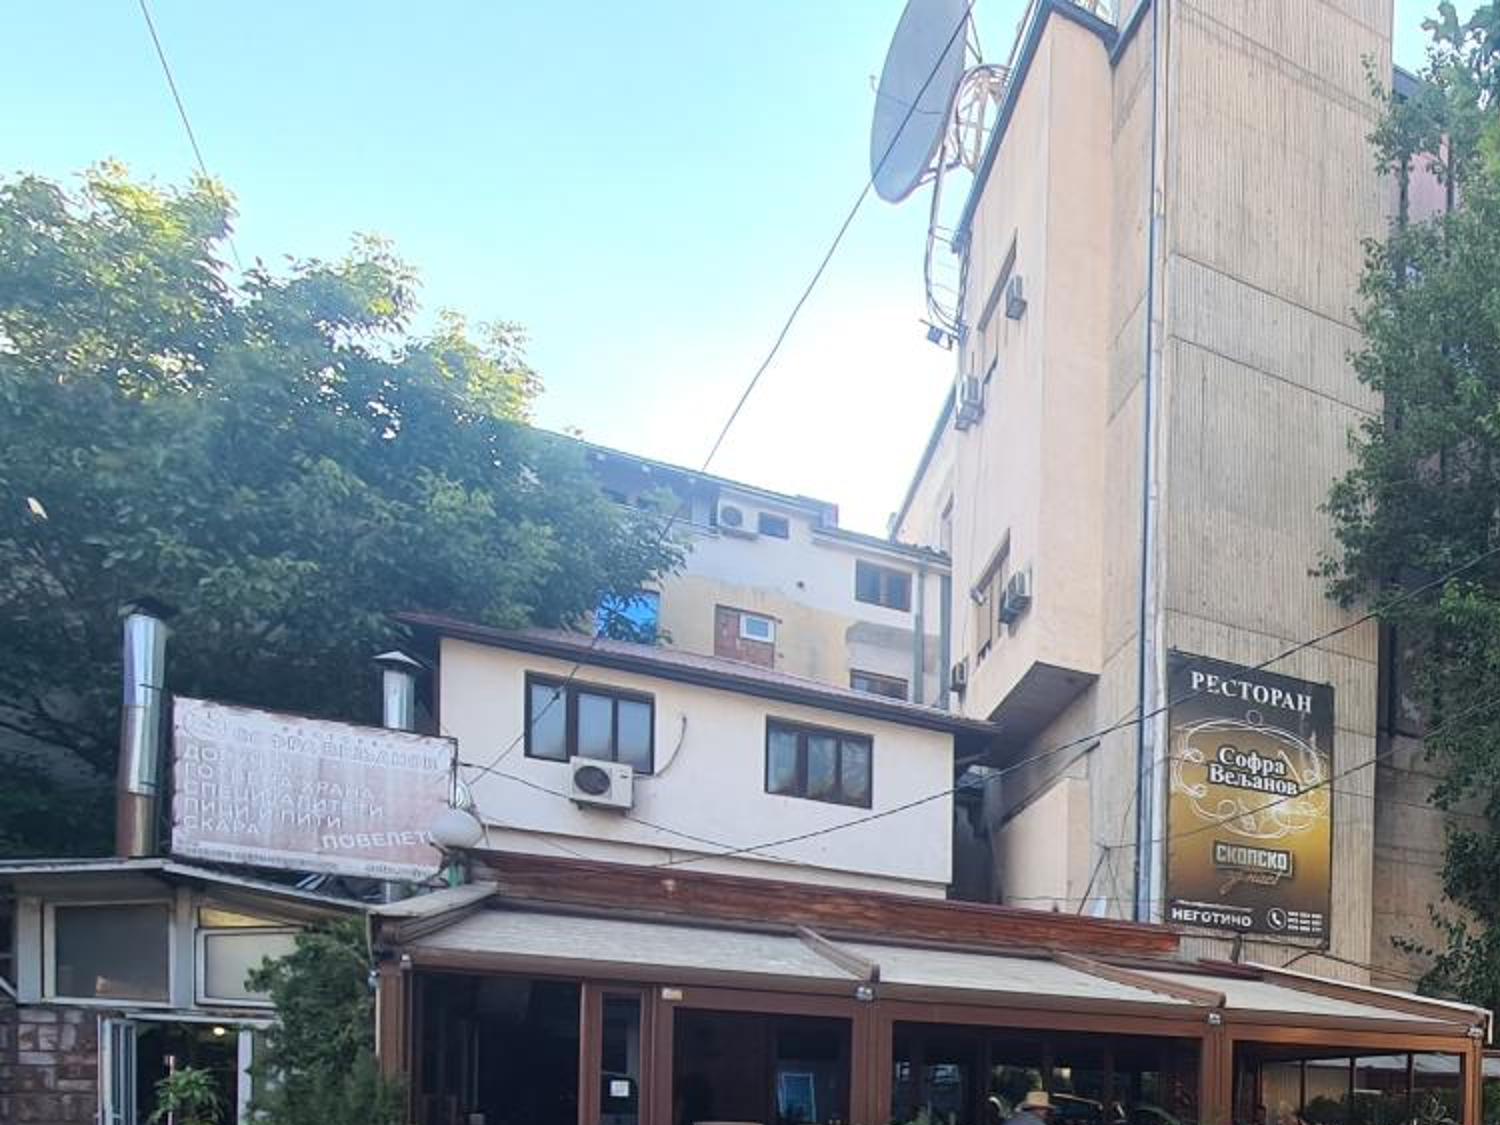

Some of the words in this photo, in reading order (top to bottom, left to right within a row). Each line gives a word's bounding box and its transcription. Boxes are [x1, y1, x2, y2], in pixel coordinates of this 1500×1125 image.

[1191, 671, 1313, 714] РЕСТОРАН
[1219, 747, 1286, 775] Софра
[184, 762, 292, 791] ГОВЕНА
[1210, 763, 1298, 796] Вељанов
[182, 814, 259, 837] СКАРА
[281, 808, 342, 830] ПИТИ
[1216, 844, 1288, 871] СКОПСКО
[1170, 907, 1253, 928] НЕГОТИНО
